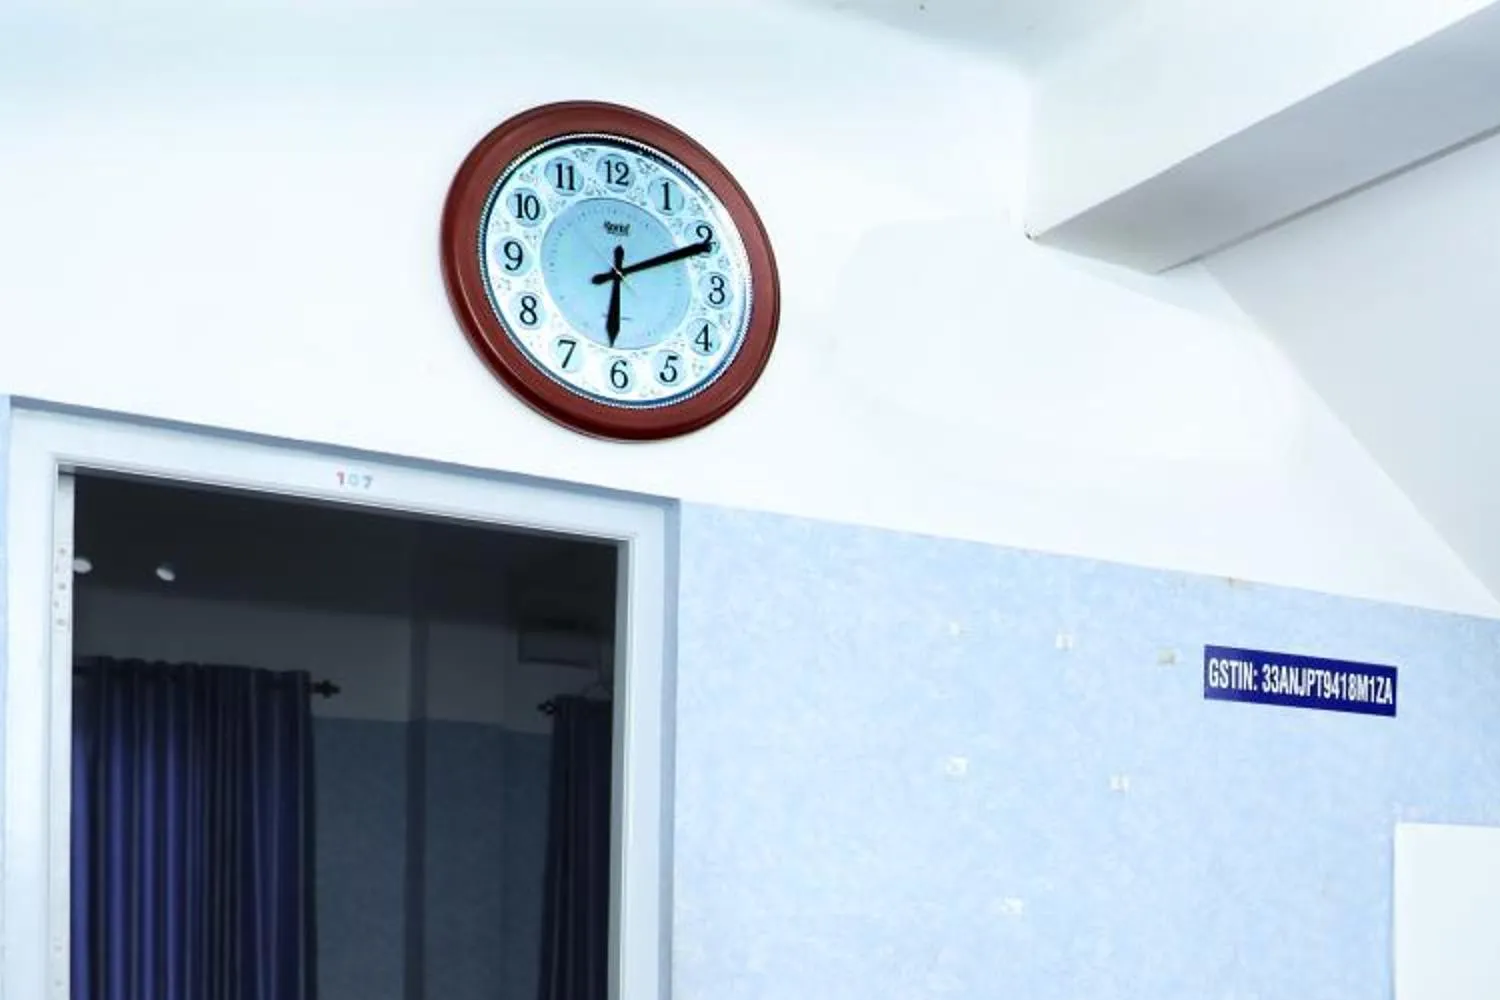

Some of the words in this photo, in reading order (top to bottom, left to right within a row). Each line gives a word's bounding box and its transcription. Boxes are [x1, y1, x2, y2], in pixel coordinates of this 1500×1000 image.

[555, 163, 576, 191] 11
[605, 161, 630, 186] 12
[516, 194, 541, 221] 10
[661, 182, 672, 211] 1
[504, 242, 523, 270] 9
[708, 276, 725, 304] 3
[519, 295, 538, 326] 8
[695, 323, 713, 352] 4
[557, 339, 577, 369] 7
[610, 360, 630, 389] 6
[659, 355, 680, 383] 5
[337, 472, 373, 489] 107
[1208, 658, 1258, 690] GSTIN:
[1261, 664, 1393, 704] 33ANJPT9418M1ZA
